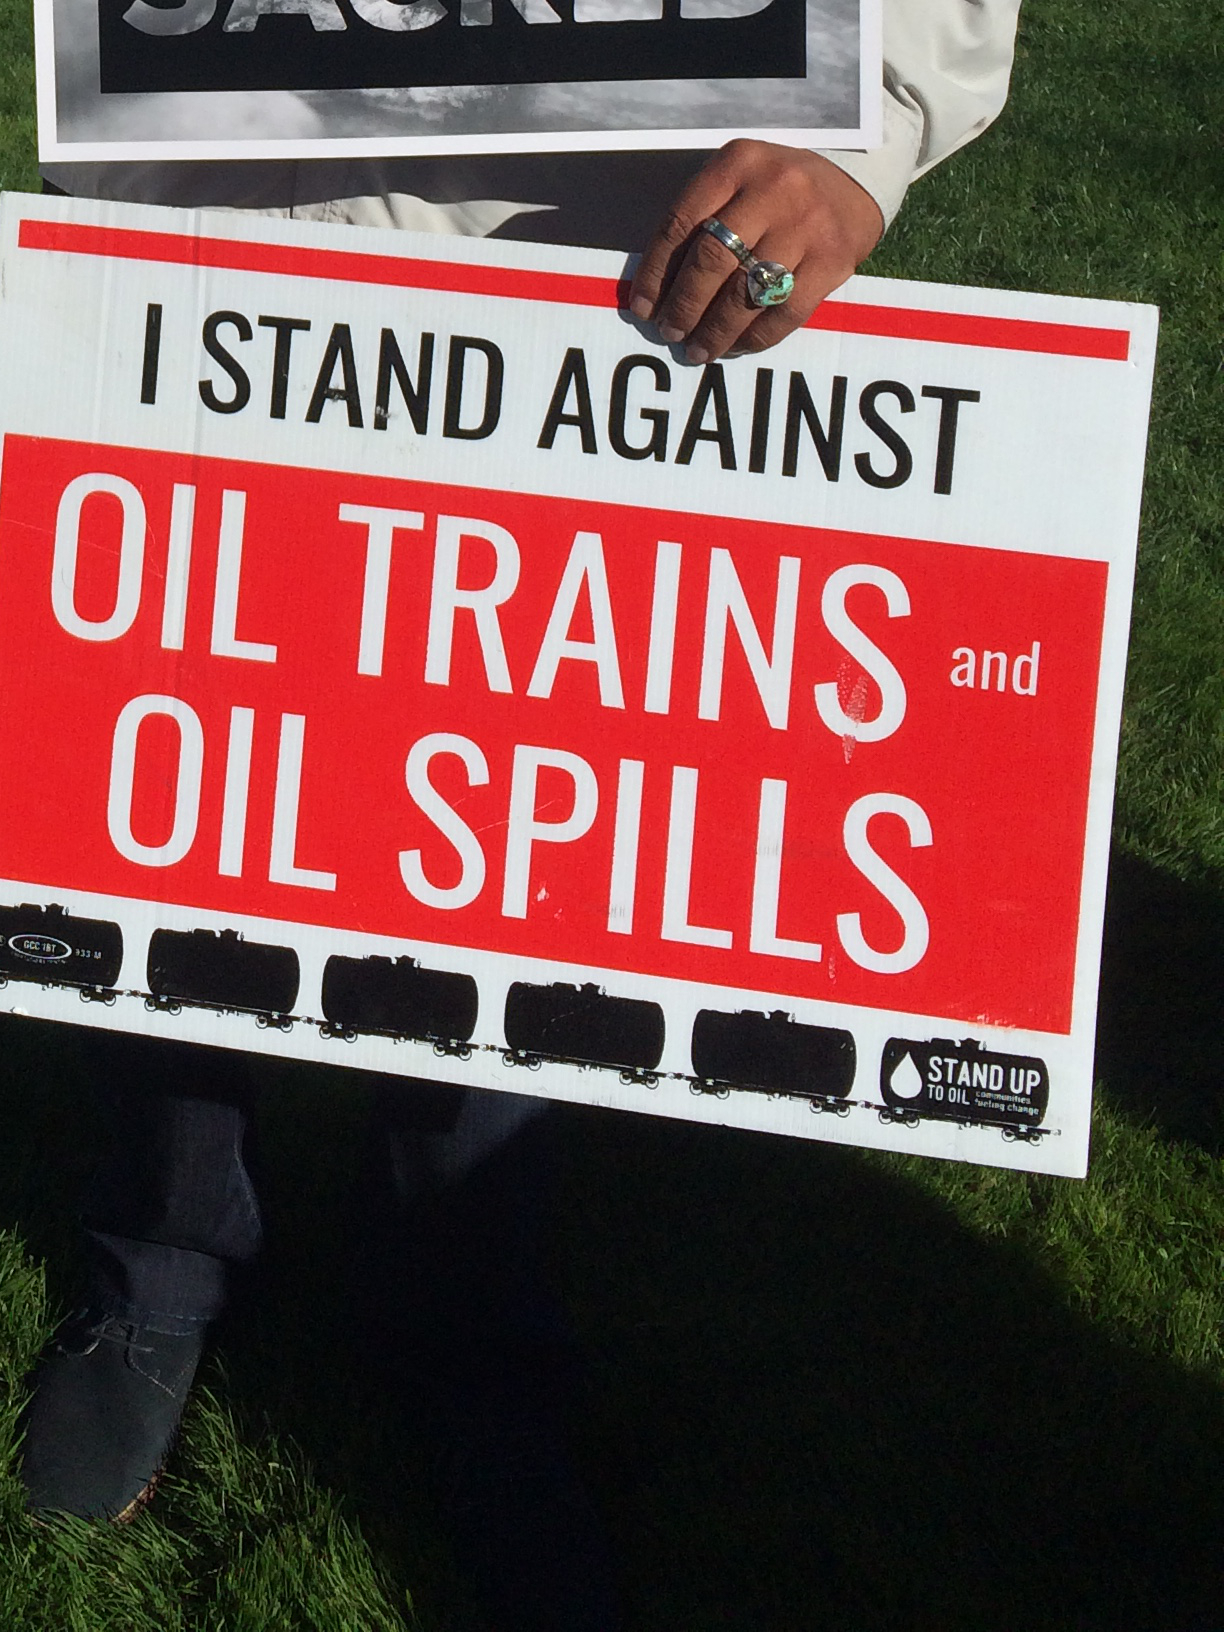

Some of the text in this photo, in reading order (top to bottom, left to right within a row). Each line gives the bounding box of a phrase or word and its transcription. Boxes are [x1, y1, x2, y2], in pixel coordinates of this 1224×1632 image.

[140, 303, 982, 496] I STAND AGAINST
[51, 472, 1041, 743] OIL TRAINS and
[108, 693, 933, 975] OIL SPILLS
[927, 1055, 1041, 1096] STAND UP
[927, 1083, 971, 1106] TO OIL
[1006, 1103, 1040, 1116] change
